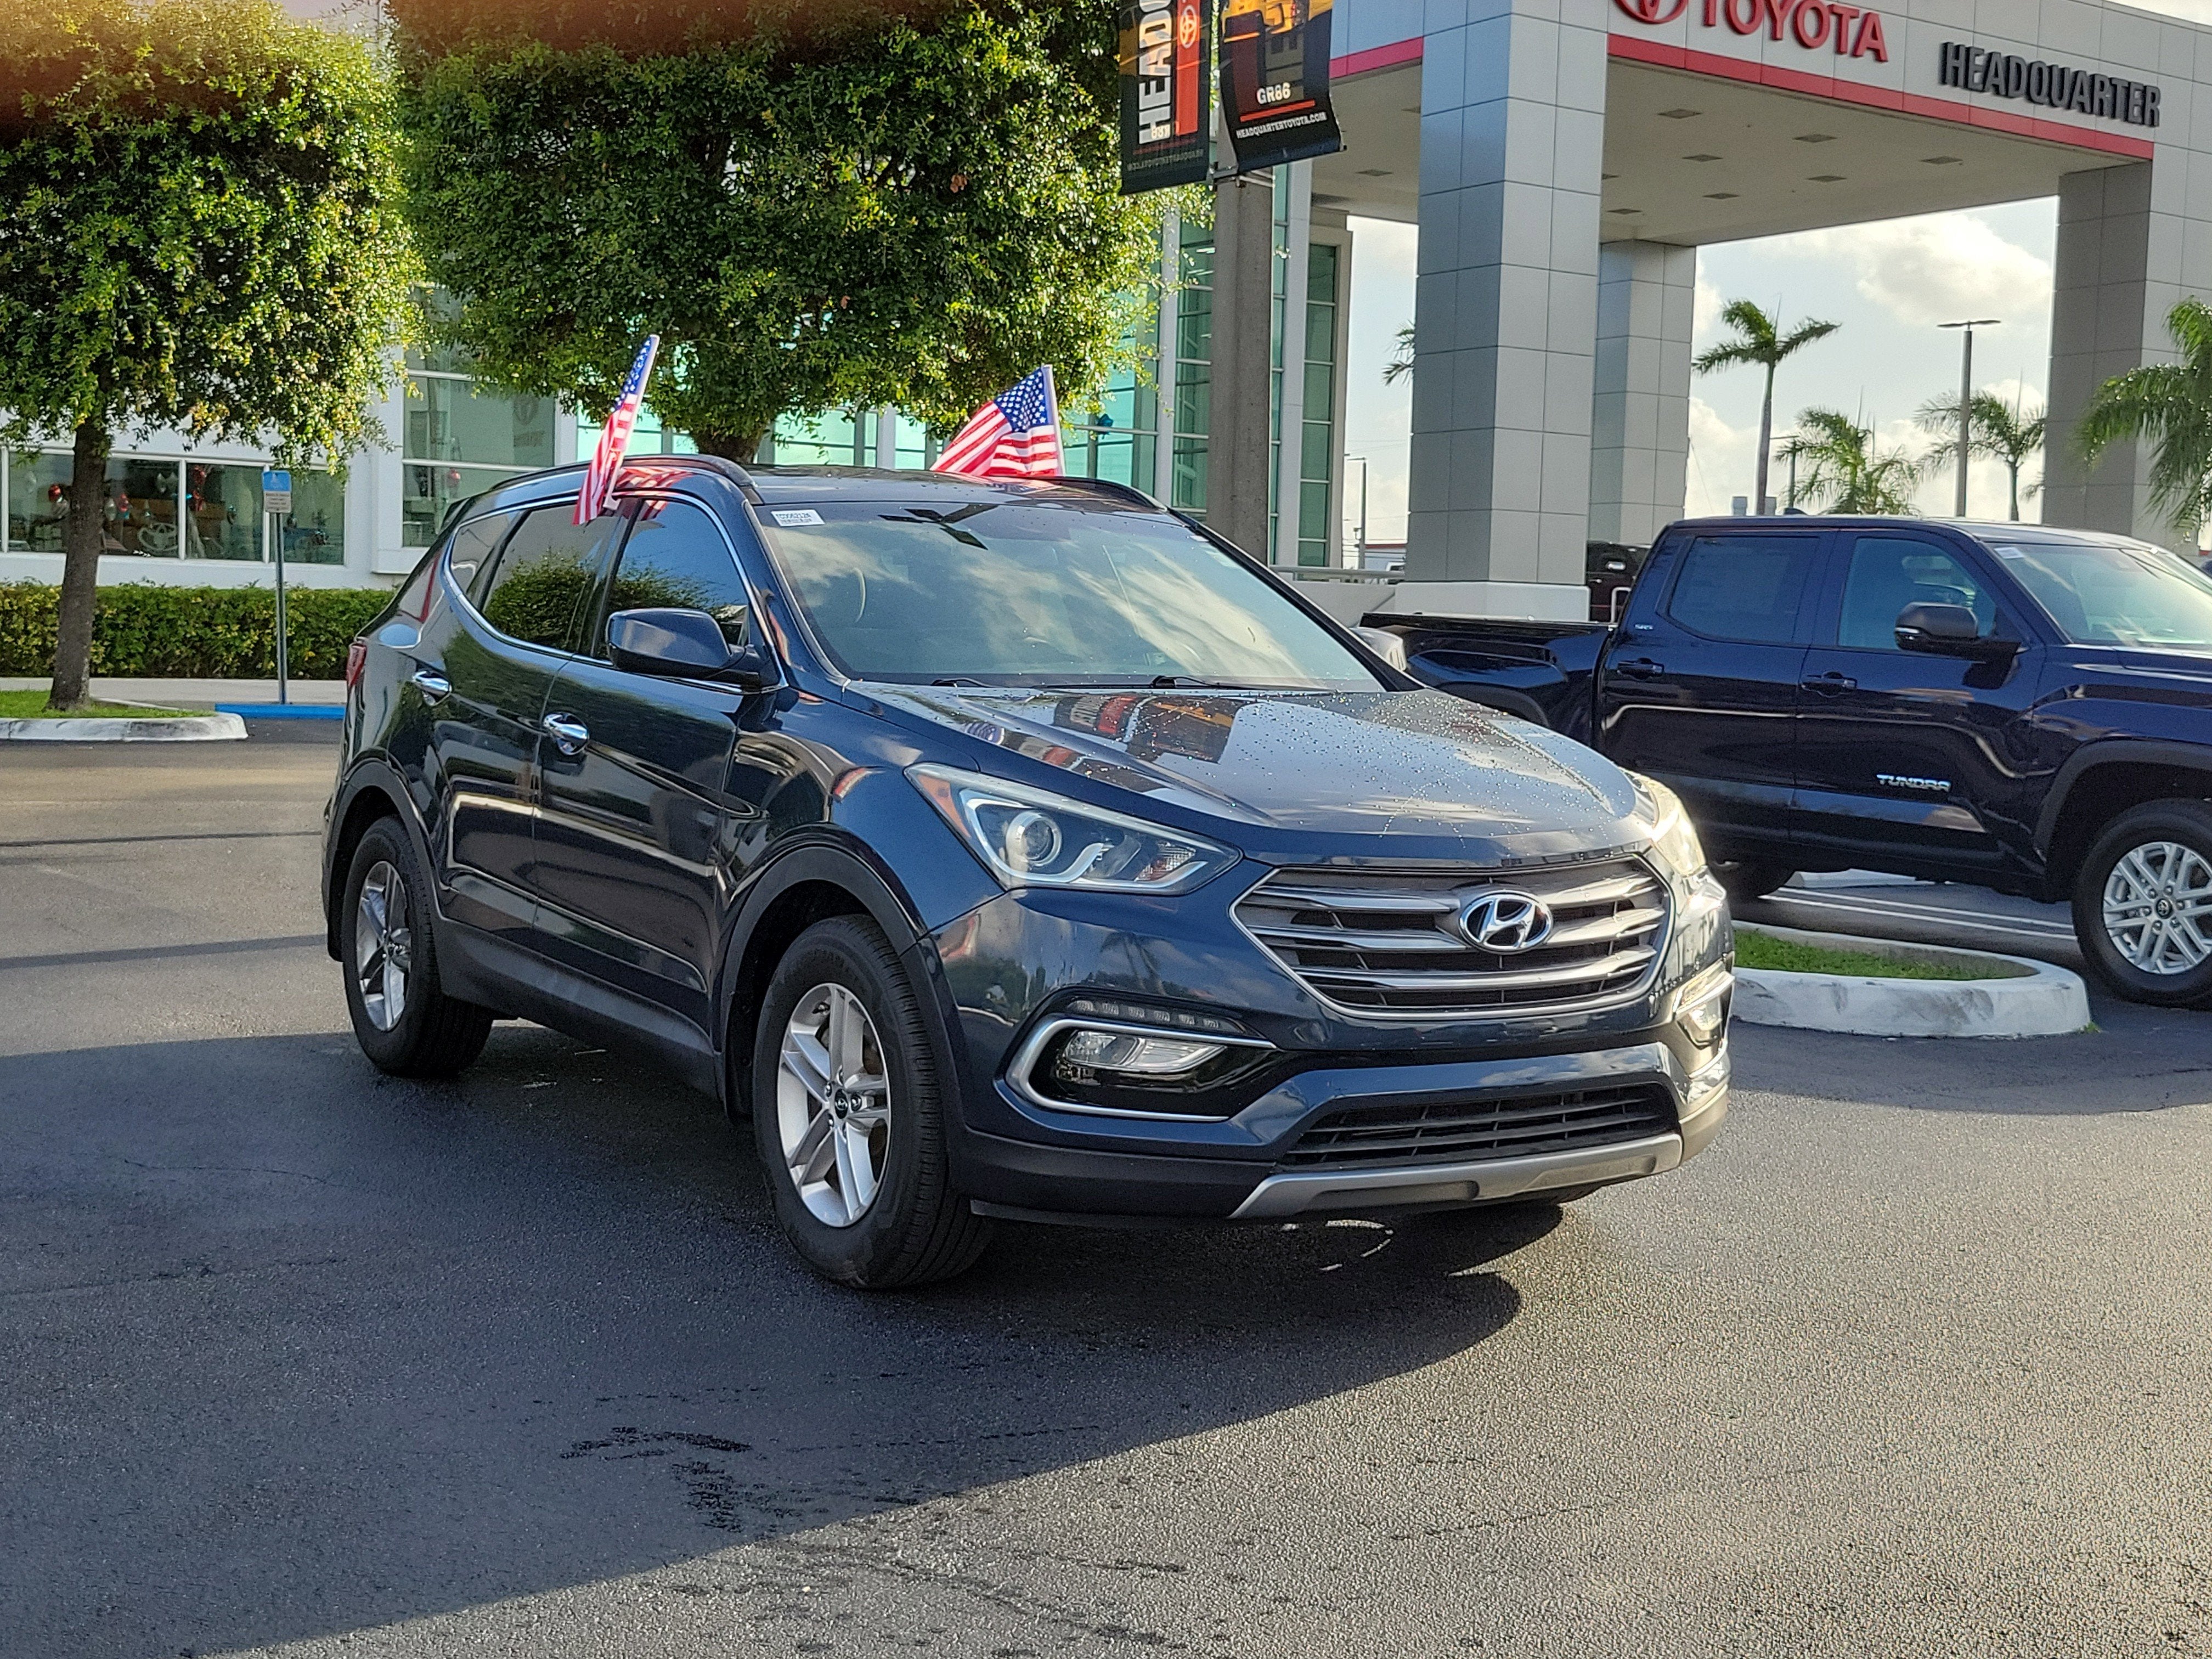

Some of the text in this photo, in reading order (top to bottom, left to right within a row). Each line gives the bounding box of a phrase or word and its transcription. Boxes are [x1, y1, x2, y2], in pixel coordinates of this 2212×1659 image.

[1256, 82, 1291, 105] GR86
[1939, 42, 2161, 127] HEADQUARTER
[1235, 111, 1328, 139] HEADQUARTERTOYOTA.COM
[1876, 774, 1951, 792] TUNDRA
